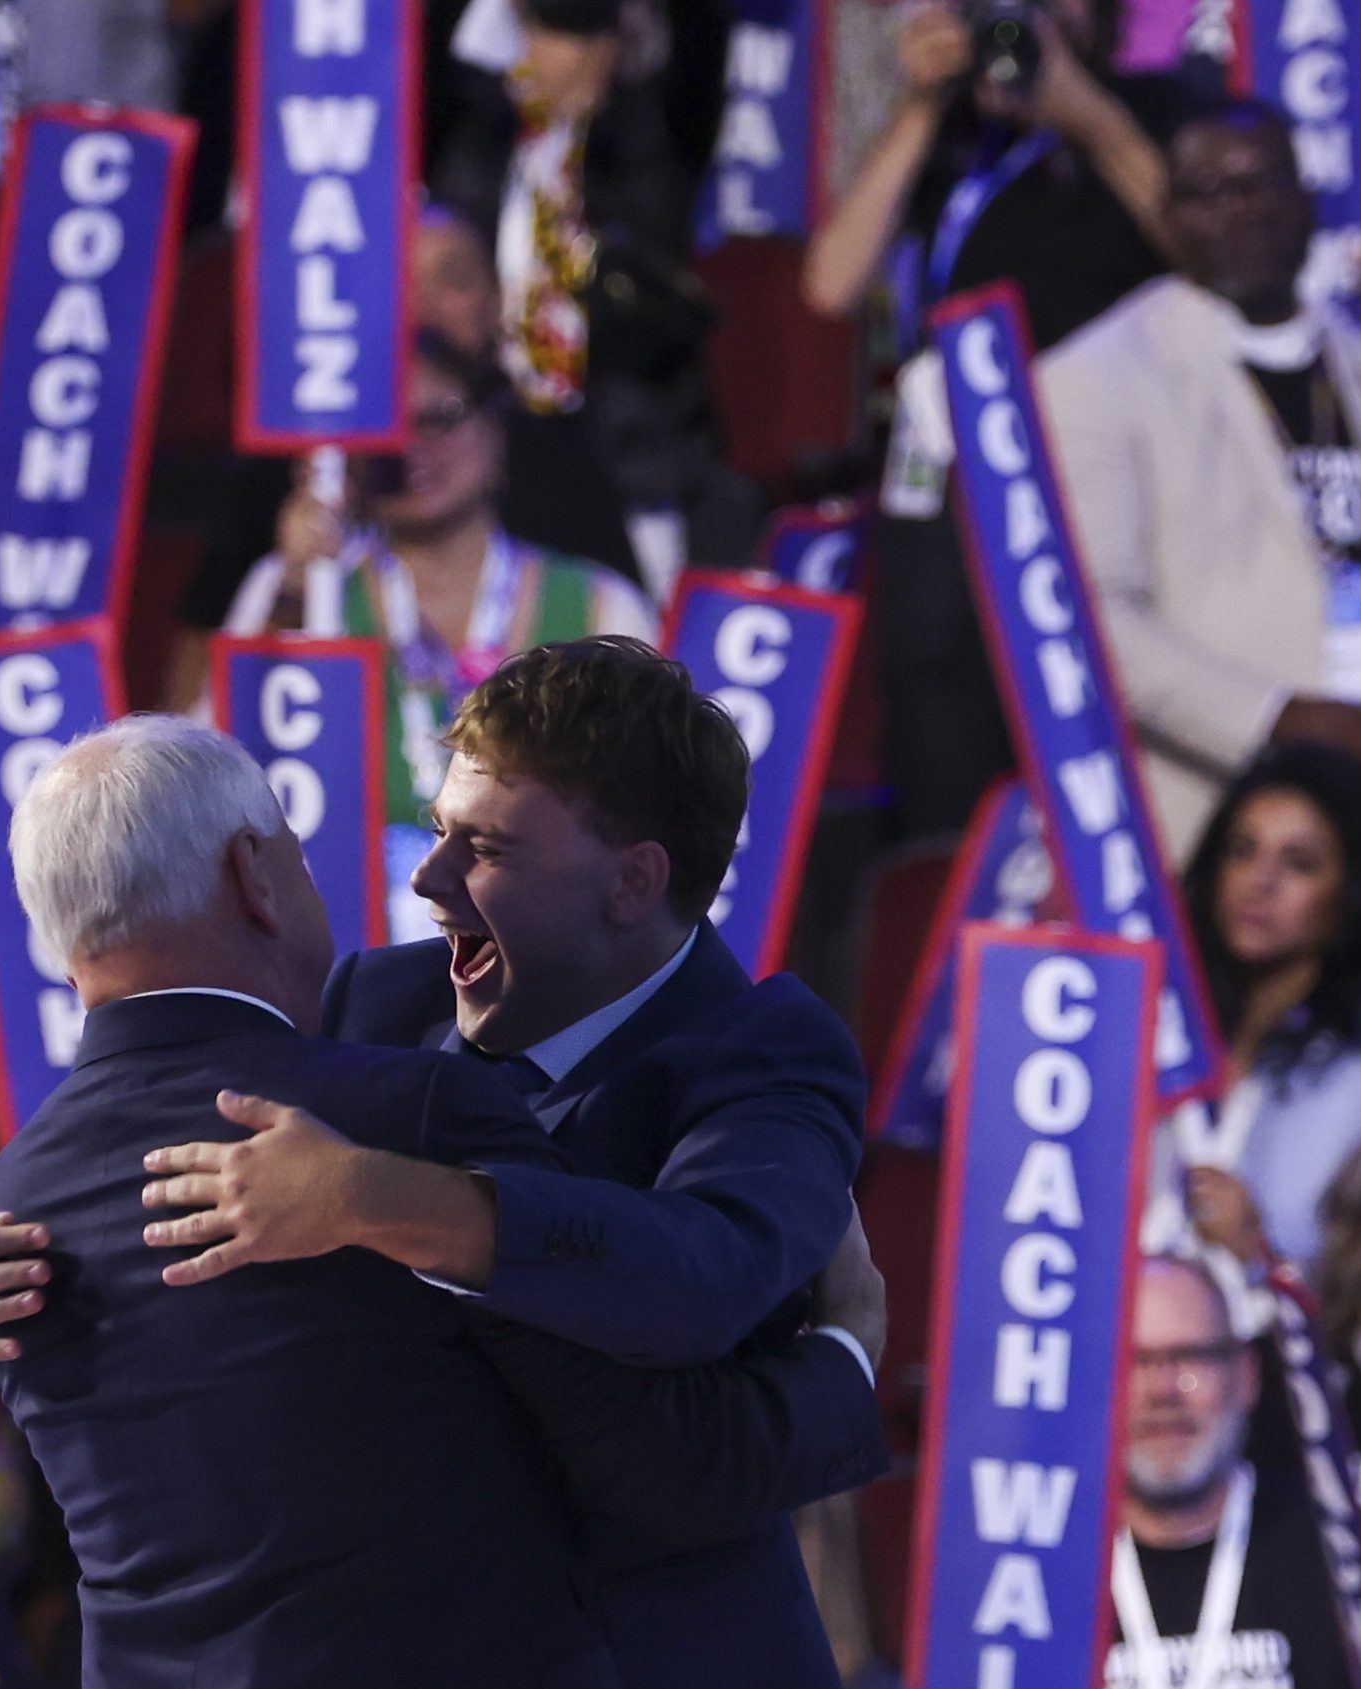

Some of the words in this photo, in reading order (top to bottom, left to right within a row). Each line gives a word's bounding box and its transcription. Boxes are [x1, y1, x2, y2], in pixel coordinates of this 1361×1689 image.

[16, 130, 136, 502] COACH
[277, 94, 380, 414] WALZ
[992, 954, 1099, 1412] COACH
